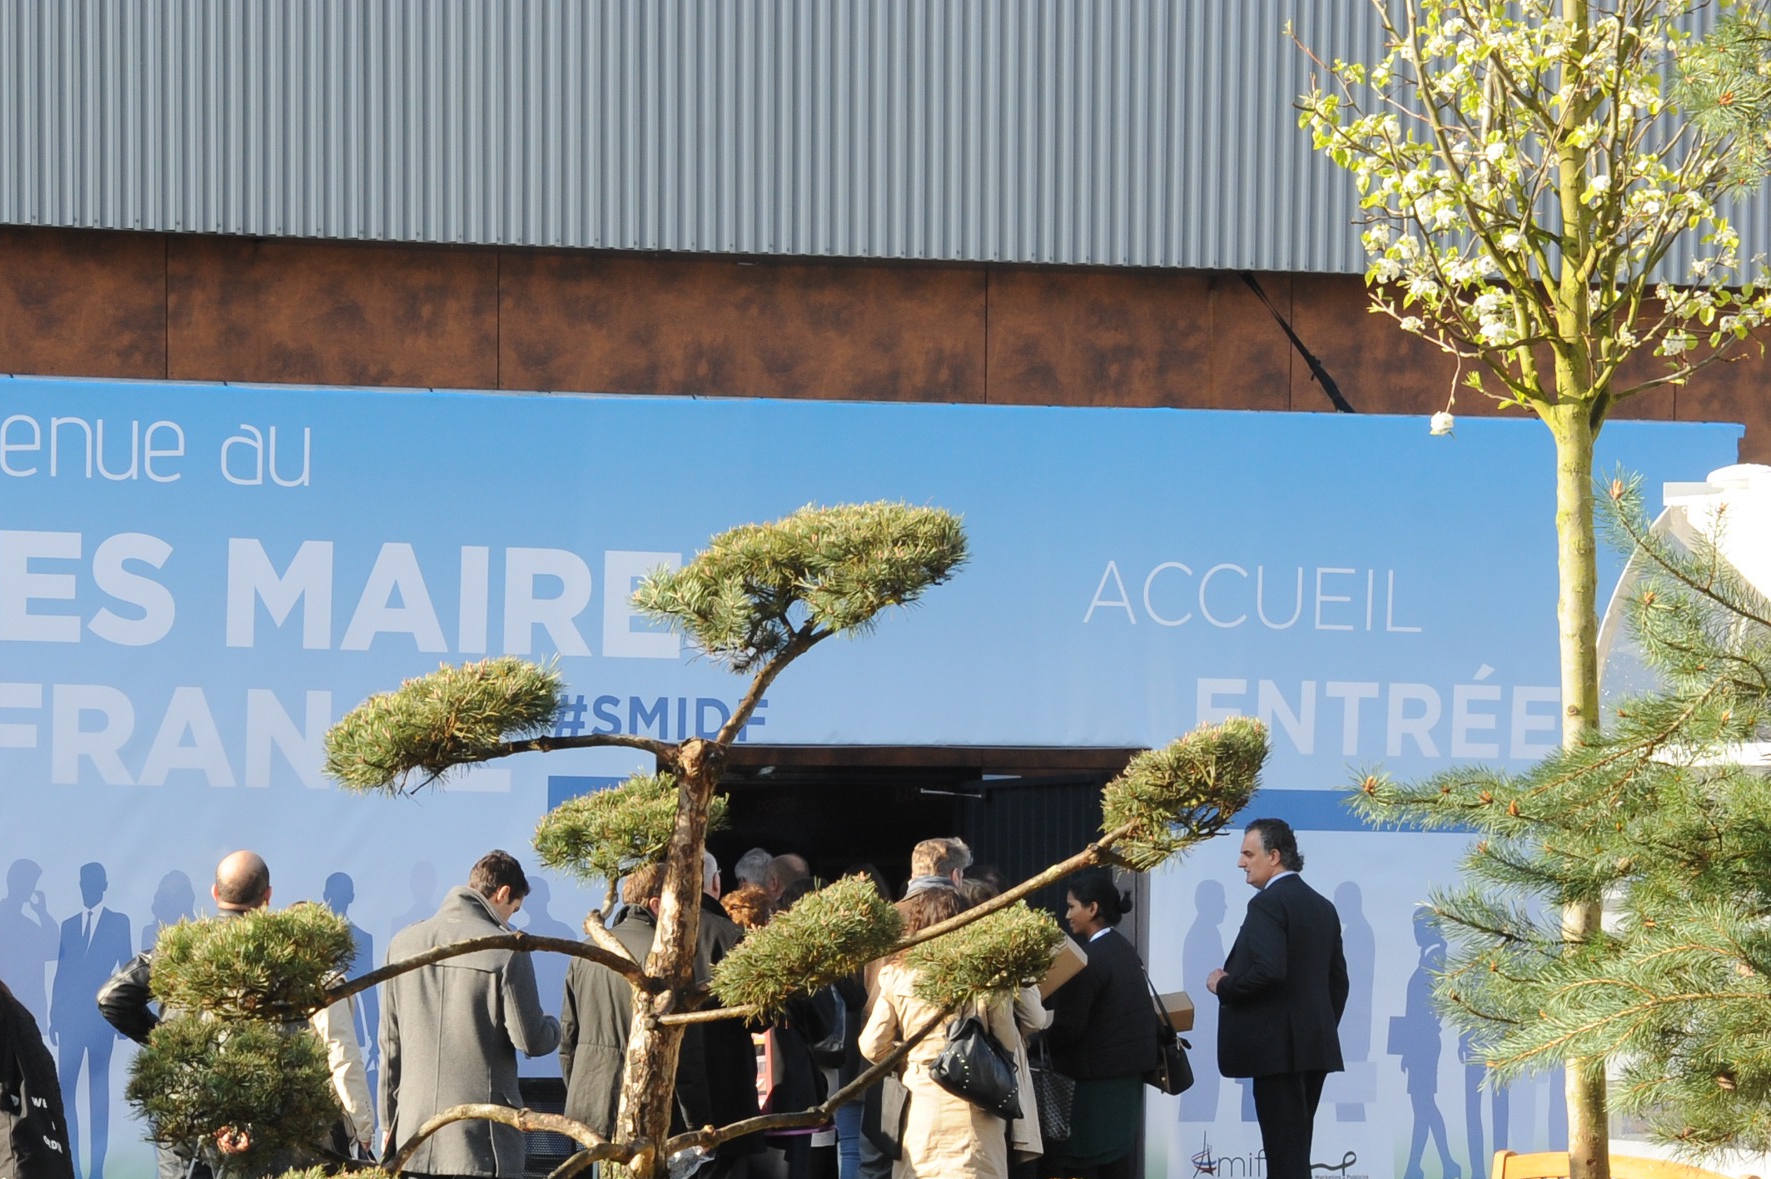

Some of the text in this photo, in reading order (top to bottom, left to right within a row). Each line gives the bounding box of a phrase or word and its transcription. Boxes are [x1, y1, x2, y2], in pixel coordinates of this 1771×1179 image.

[219, 423, 311, 488] au
[226, 536, 763, 662] MAIRE
[1082, 559, 1422, 634] ACCUEIL
